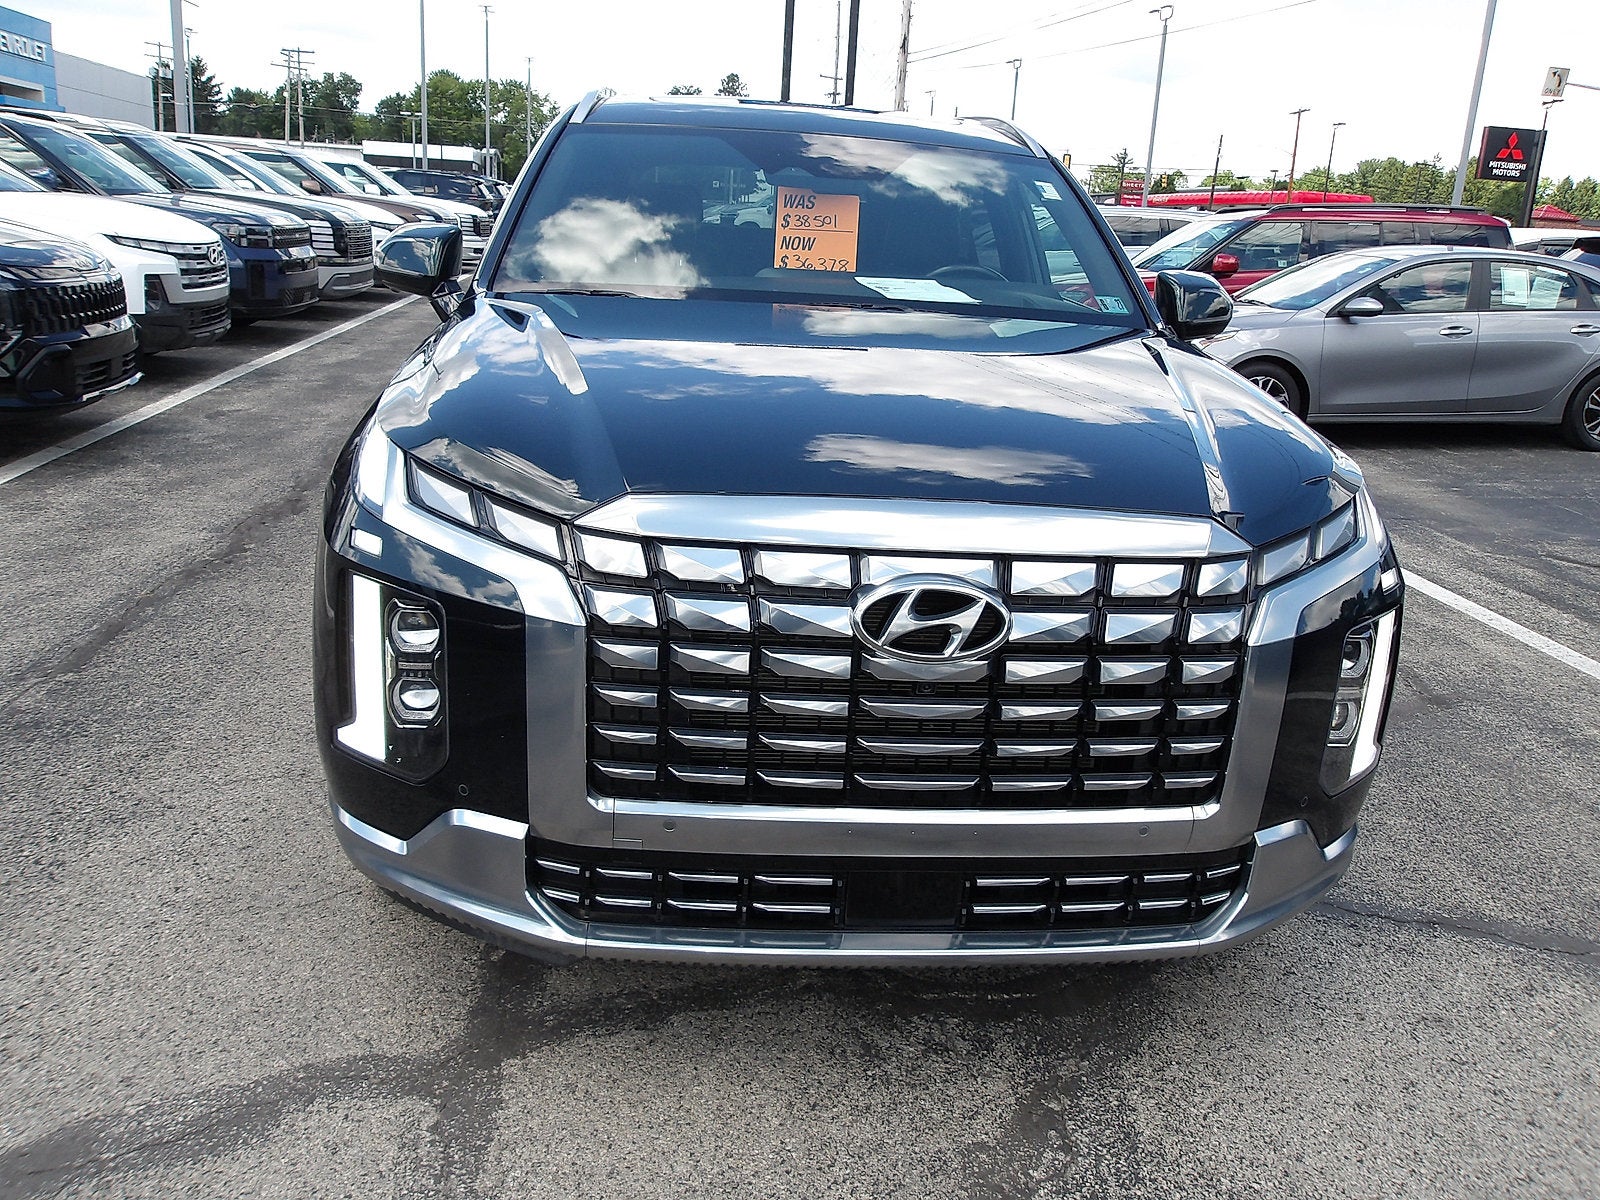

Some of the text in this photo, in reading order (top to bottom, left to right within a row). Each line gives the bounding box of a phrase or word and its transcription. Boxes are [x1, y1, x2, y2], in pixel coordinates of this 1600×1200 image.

[1489, 161, 1527, 170] MITSUBISHI
[1492, 168, 1520, 177] MOTORS
[783, 193, 816, 210] WAS
[780, 236, 816, 251] NOW
